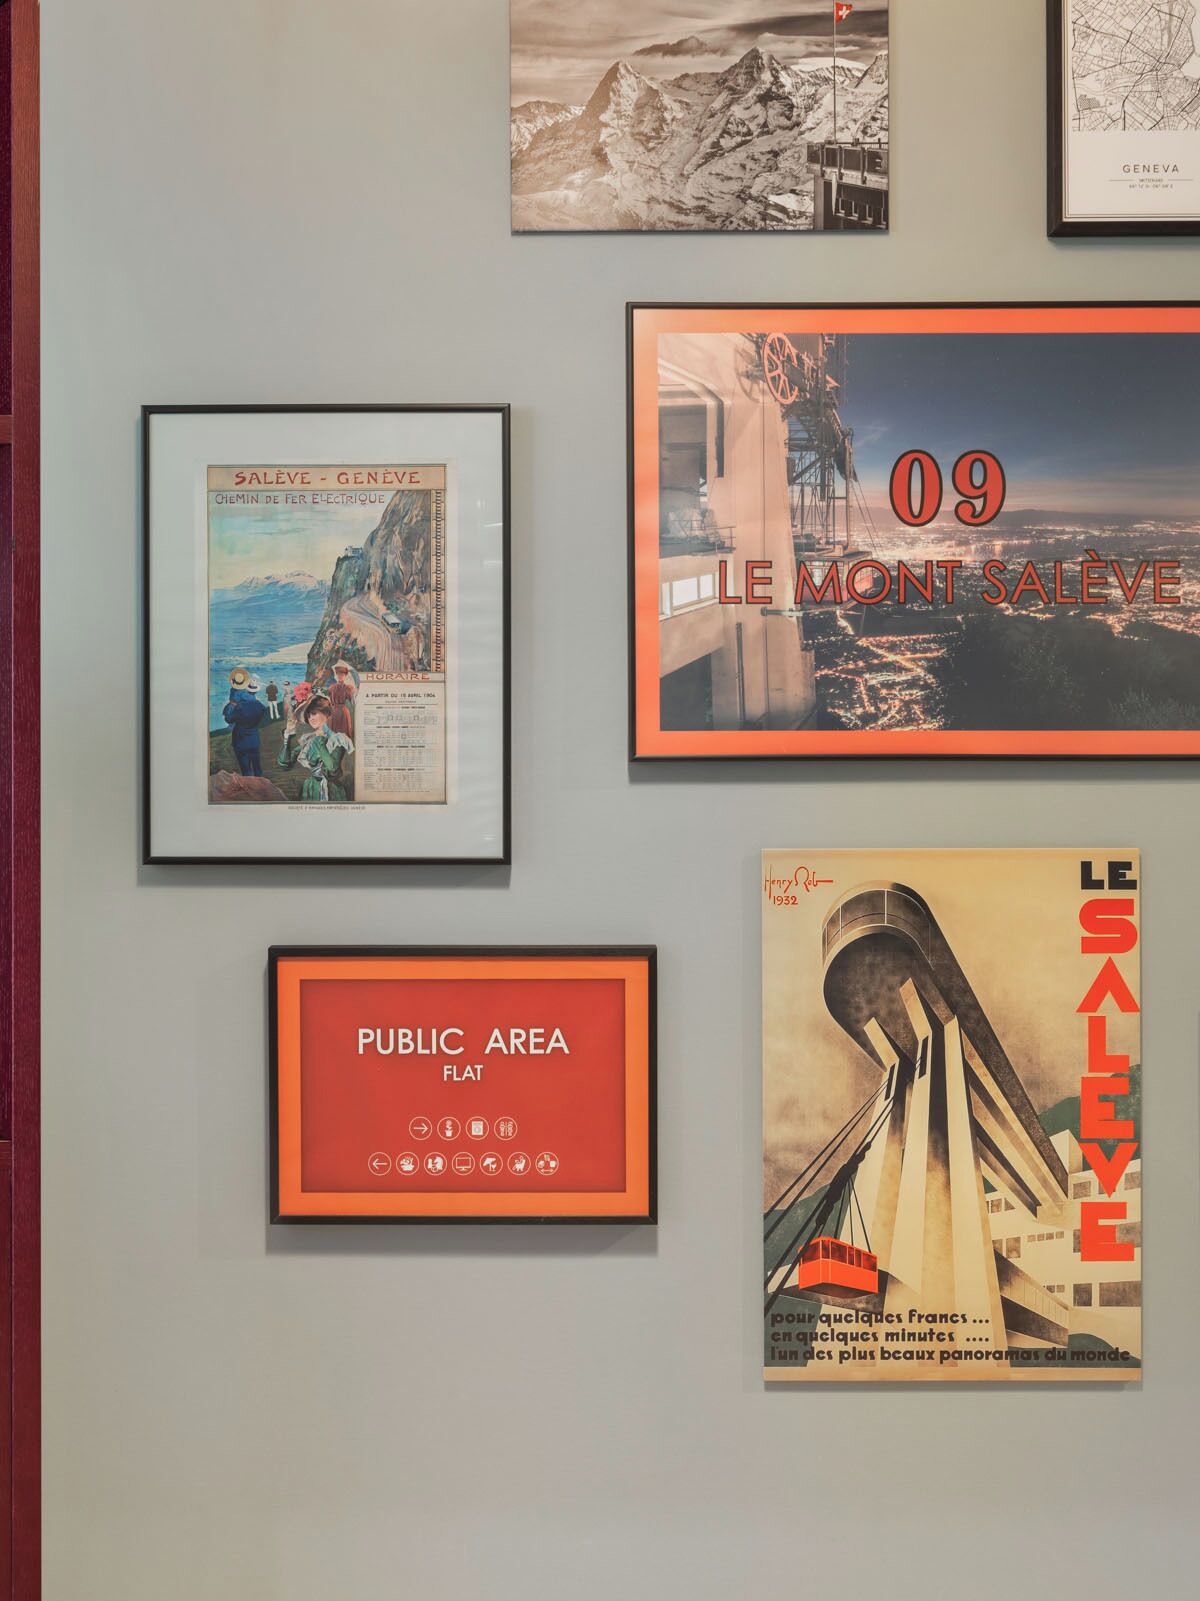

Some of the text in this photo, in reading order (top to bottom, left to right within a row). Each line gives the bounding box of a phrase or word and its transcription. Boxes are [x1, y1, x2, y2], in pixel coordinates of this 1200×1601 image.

[1122, 164, 1179, 173] GENEVA
[234, 469, 311, 486] SALÈVE
[337, 469, 421, 485] GENÈVE
[889, 449, 1007, 527] 09
[215, 493, 386, 506] CHEMIN DE FER ELECTRIQUE
[718, 548, 1182, 605] LE MONT SALÈVE
[365, 672, 431, 681] HORAIRE
[1080, 861, 1138, 890] LE
[773, 895, 799, 906] 1932
[357, 1027, 570, 1055] PUBLIC AREA
[443, 1064, 484, 1081] FLAT
[770, 1312, 815, 1327] pour
[819, 1310, 903, 1328] quelques
[908, 1309, 968, 1324] francs
[771, 1331, 793, 1343] en
[796, 1328, 879, 1346] quelques
[884, 1328, 955, 1343] minutes
[771, 1346, 1131, 1365] l'un des plus beaux panoramas du monde
